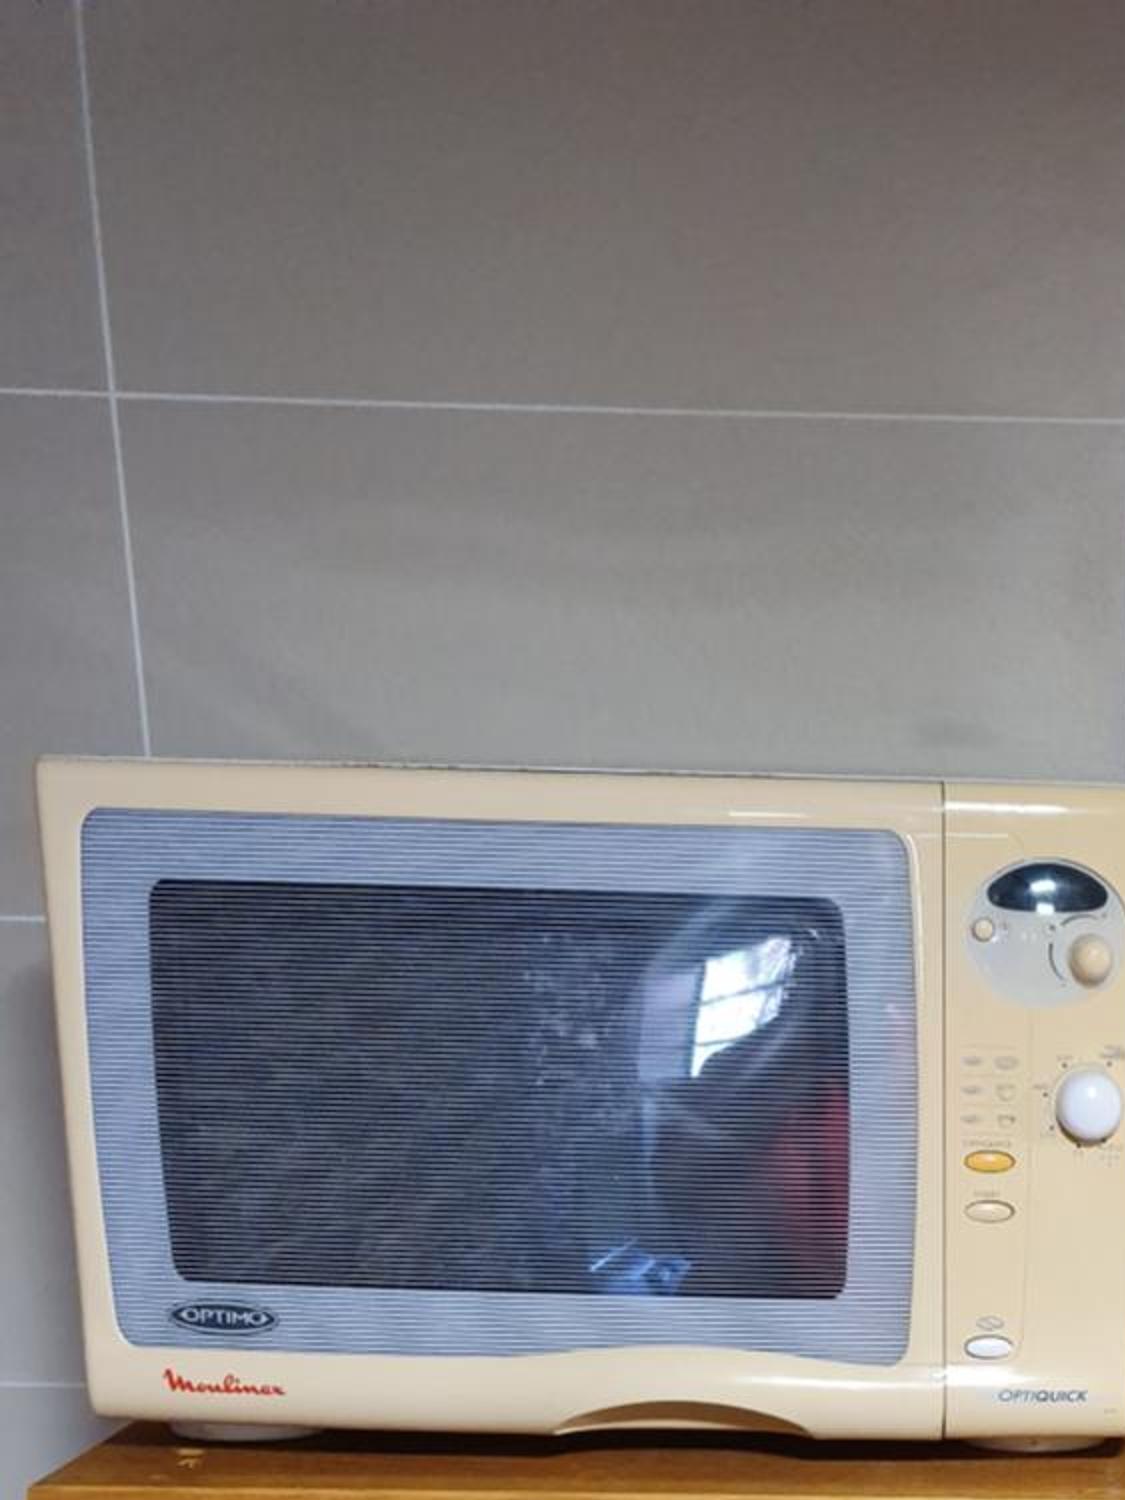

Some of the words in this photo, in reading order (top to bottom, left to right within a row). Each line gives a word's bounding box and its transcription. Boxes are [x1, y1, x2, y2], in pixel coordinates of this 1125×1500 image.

[180, 1306, 271, 1327] OPTIMO
[163, 1368, 286, 1396] Moulinex
[998, 1389, 1088, 1403] OPTIQUICK
